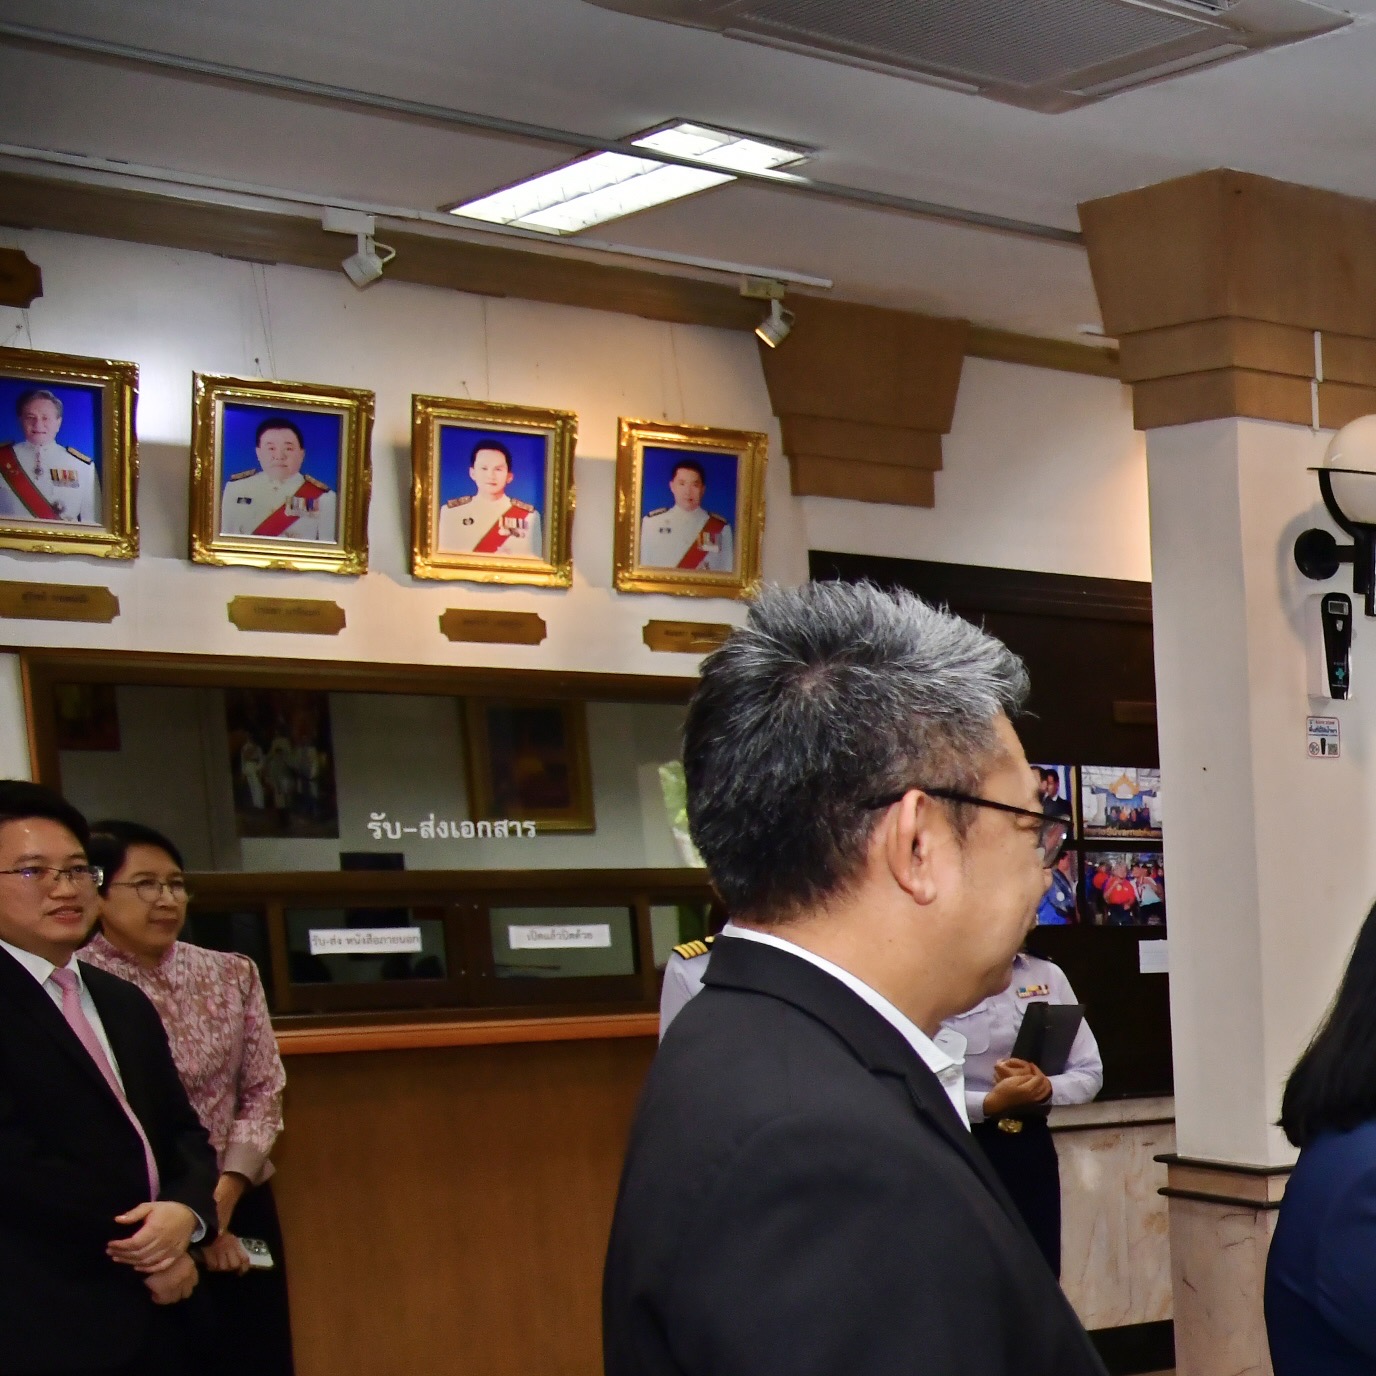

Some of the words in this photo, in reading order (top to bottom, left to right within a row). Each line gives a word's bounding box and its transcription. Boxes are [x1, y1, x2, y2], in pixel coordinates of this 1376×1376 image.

[366, 811, 537, 841] รับ-ส่งเอกสาร
